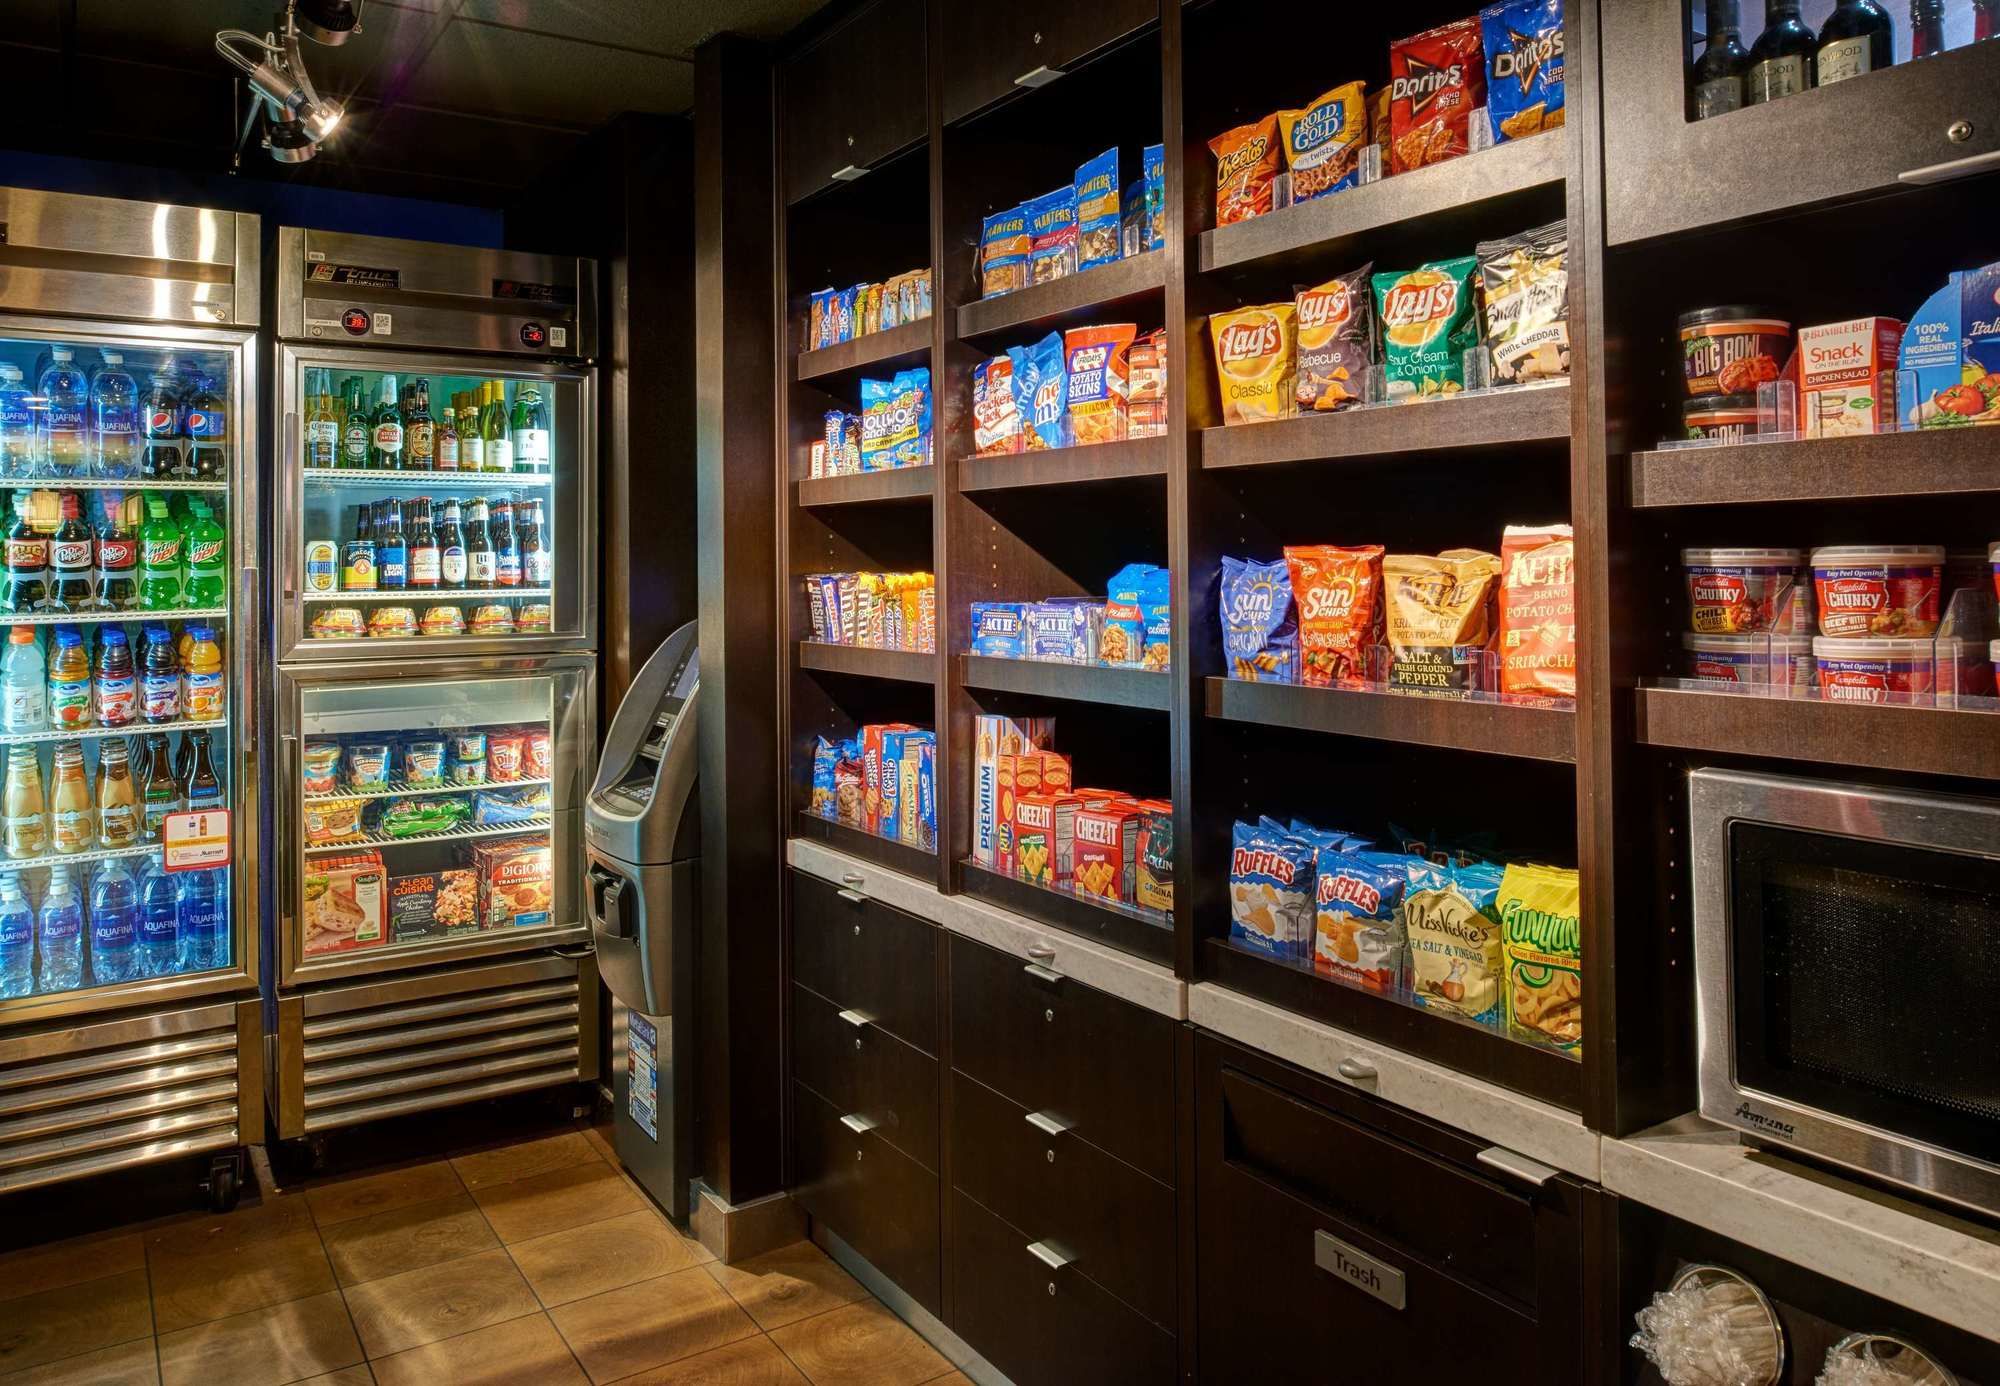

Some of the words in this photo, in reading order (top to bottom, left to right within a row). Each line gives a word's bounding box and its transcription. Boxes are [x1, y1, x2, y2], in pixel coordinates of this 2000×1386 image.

[1494, 31, 1565, 79] Doritos
[1392, 64, 1461, 100] Doritos
[1301, 103, 1339, 128] ROLD
[1295, 117, 1340, 150] GOLD
[1217, 135, 1267, 190] Cheetos
[1034, 208, 1072, 231] PLANTERS
[1386, 284, 1451, 326] Lay's
[1521, 328, 1560, 346] CHEDDAR
[1914, 322, 1950, 336] 100%
[1223, 320, 1278, 362] Lay's
[1919, 334, 1943, 344] REAL
[1810, 342, 1864, 363] Snack
[1905, 341, 1958, 355] INGREDIENTS
[1299, 352, 1342, 369] Barbecue
[1389, 354, 1407, 366] Sour
[1410, 350, 1449, 364] Cream
[1694, 341, 1720, 377] BIG
[1069, 370, 1102, 386] POTATO
[1405, 363, 1438, 377] Onion
[1807, 374, 1841, 384] CHICKEN
[1842, 369, 1869, 379] SALAD
[1068, 381, 1101, 398] SKINS
[1230, 382, 1273, 400] Classic
[42, 412, 81, 423] AQUAFINA
[1715, 567, 1742, 575] Opening
[1840, 569, 1853, 577] Peel
[1854, 569, 1885, 577] Opening
[1534, 589, 1568, 600] BRAND
[1694, 586, 1741, 604] CHUNKY
[1829, 591, 1881, 609] CHUNKY
[1228, 594, 1272, 625] Sun
[1303, 587, 1353, 620] Sun
[1318, 607, 1350, 617] CHIPS
[1505, 605, 1555, 618] POTATO
[1242, 610, 1271, 621] CHIPS
[1825, 617, 1848, 629] BEEF
[1850, 615, 1866, 625] WITH
[986, 618, 1003, 631] ACT
[1003, 618, 1013, 631] II
[1040, 618, 1058, 631] ACT
[1059, 618, 1068, 631] II
[1401, 651, 1431, 664] SALT
[1433, 653, 1442, 664] &
[1508, 654, 1576, 670] SRIRACHA
[1840, 661, 1853, 669] Peel
[1854, 661, 1885, 670] Opening
[1417, 664, 1453, 673] GROUND
[1399, 672, 1449, 687] PEPPER
[1829, 683, 1881, 703] CHUNKY
[864, 753, 874, 789] Butter
[870, 748, 879, 786] Nutter
[887, 759, 896, 790] Chips
[921, 773, 930, 817] OREO
[980, 765, 991, 850] PREMIUM
[1016, 802, 1051, 829] CHEEZ-IT
[1076, 815, 1119, 847] CHEEZ-IT
[1231, 848, 1296, 886] RUFFLES
[408, 876, 434, 887] Lean
[498, 876, 541, 885] TRADITIONAL
[1317, 874, 1381, 915] RUFFLES
[144, 918, 180, 931] AQUAFINA
[189, 912, 225, 924] AQUAFINA
[1406, 903, 1442, 932] Miss
[1440, 909, 1489, 949] Vickie's
[44, 924, 77, 936] AQUAFINA
[96, 924, 134, 938] AQUAFINA
[1423, 940, 1442, 954] SALT
[1445, 945, 1452, 956] &
[1453, 946, 1483, 964] VINEGAR
[1735, 1102, 1796, 1134] Amana
[1333, 1249, 1380, 1291] Trash
